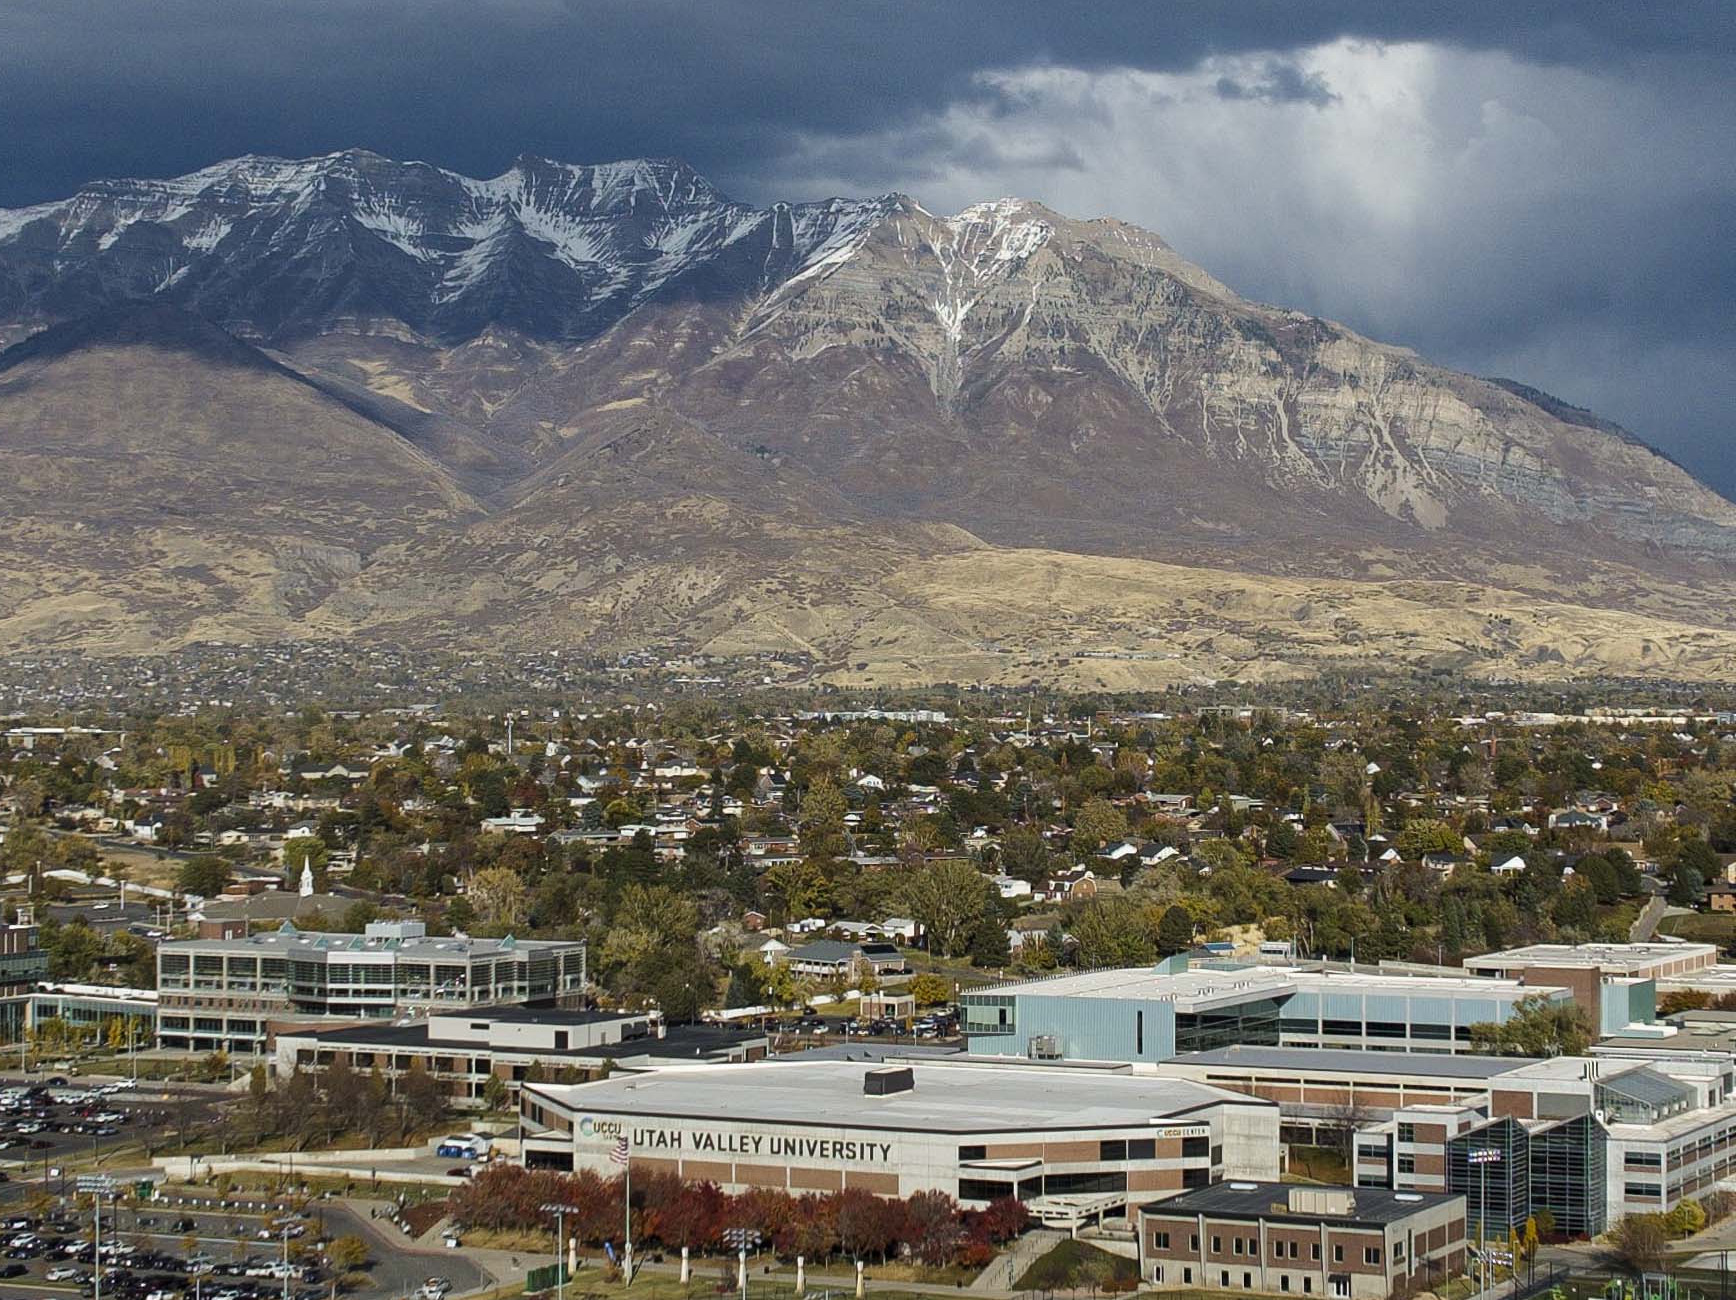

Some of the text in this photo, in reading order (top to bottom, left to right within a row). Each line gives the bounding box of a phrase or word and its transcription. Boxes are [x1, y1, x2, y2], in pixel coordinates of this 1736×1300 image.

[593, 1122, 622, 1134] UCCU
[633, 1128, 891, 1162] UTAH VALLEY UNIVERSITY
